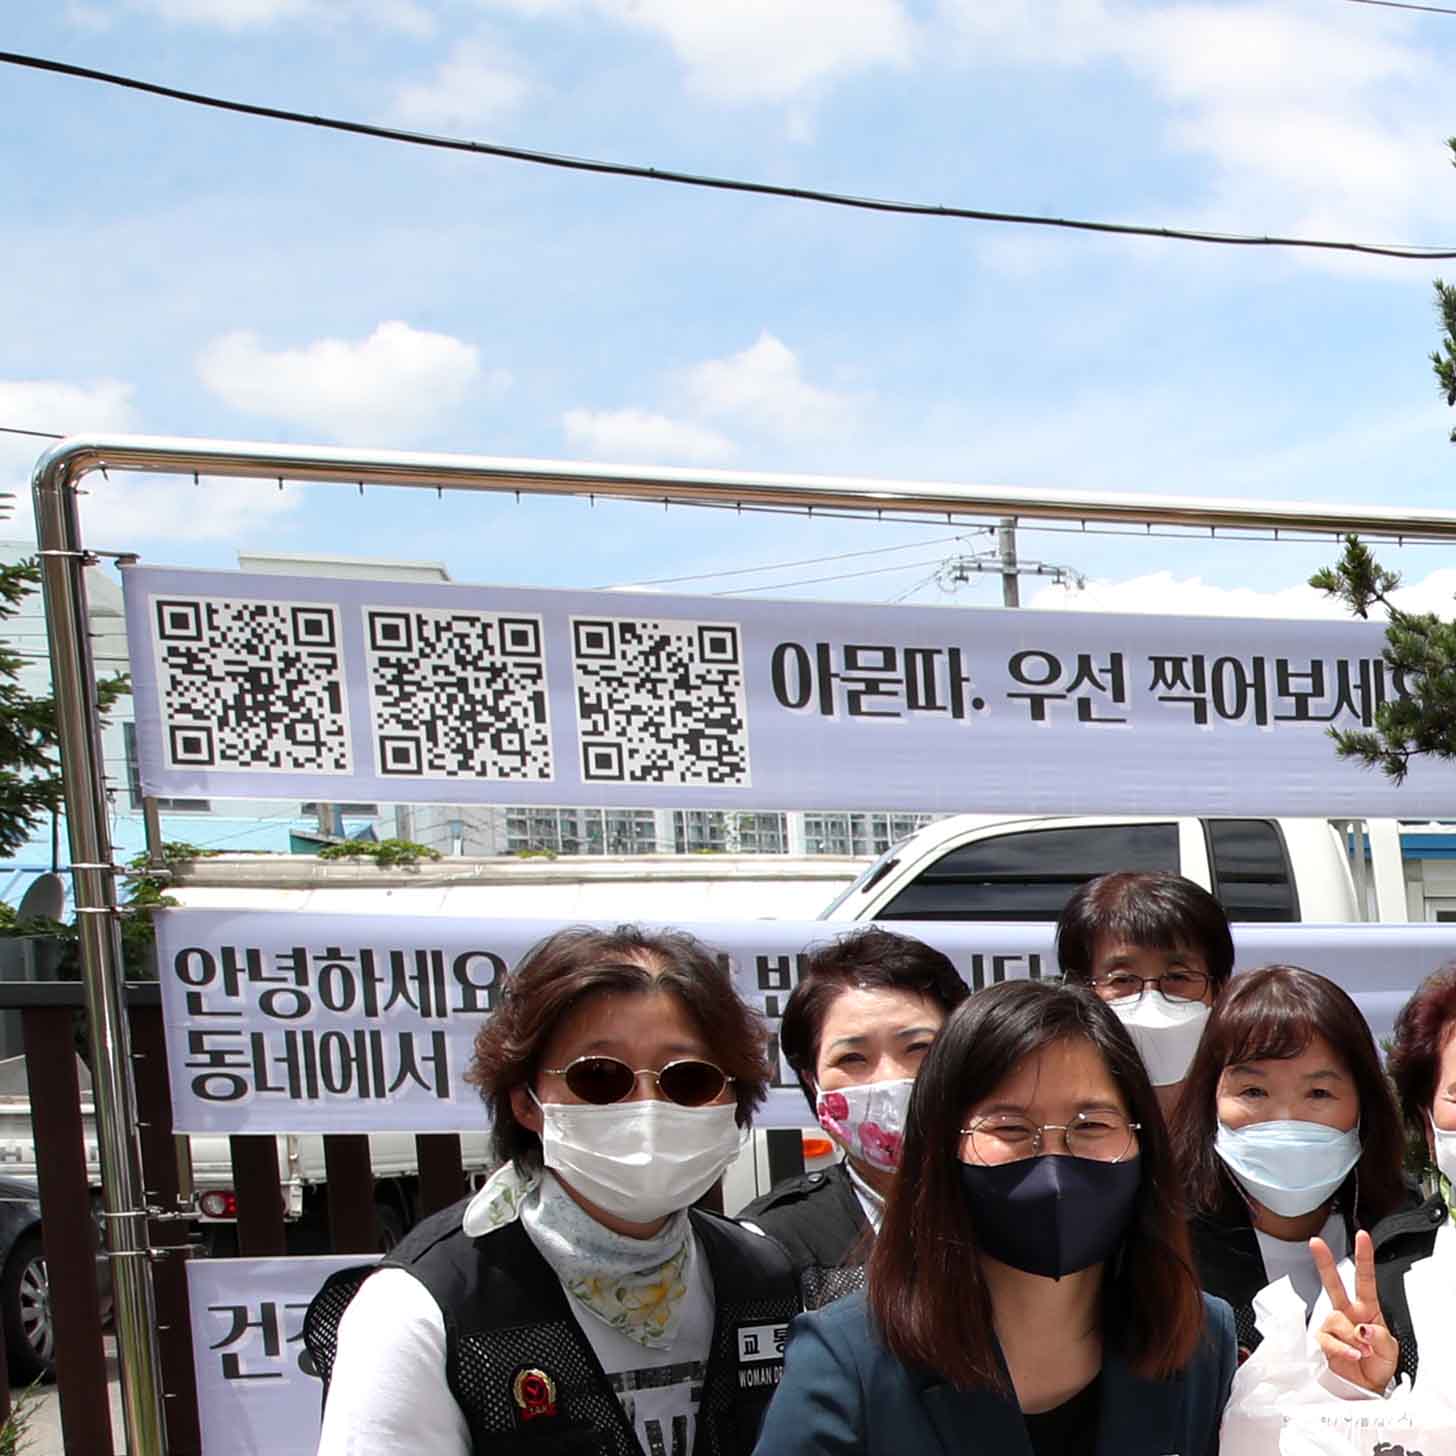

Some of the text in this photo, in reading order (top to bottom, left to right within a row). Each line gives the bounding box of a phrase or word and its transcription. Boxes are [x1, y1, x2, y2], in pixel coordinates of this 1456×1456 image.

[771, 641, 985, 719] 아묻따.
[1007, 650, 1127, 723] 우선
[174, 945, 507, 1019] 안녕하세요
[185, 1029, 451, 1102] 동네에서
[738, 1368, 772, 1389] WOMAN
